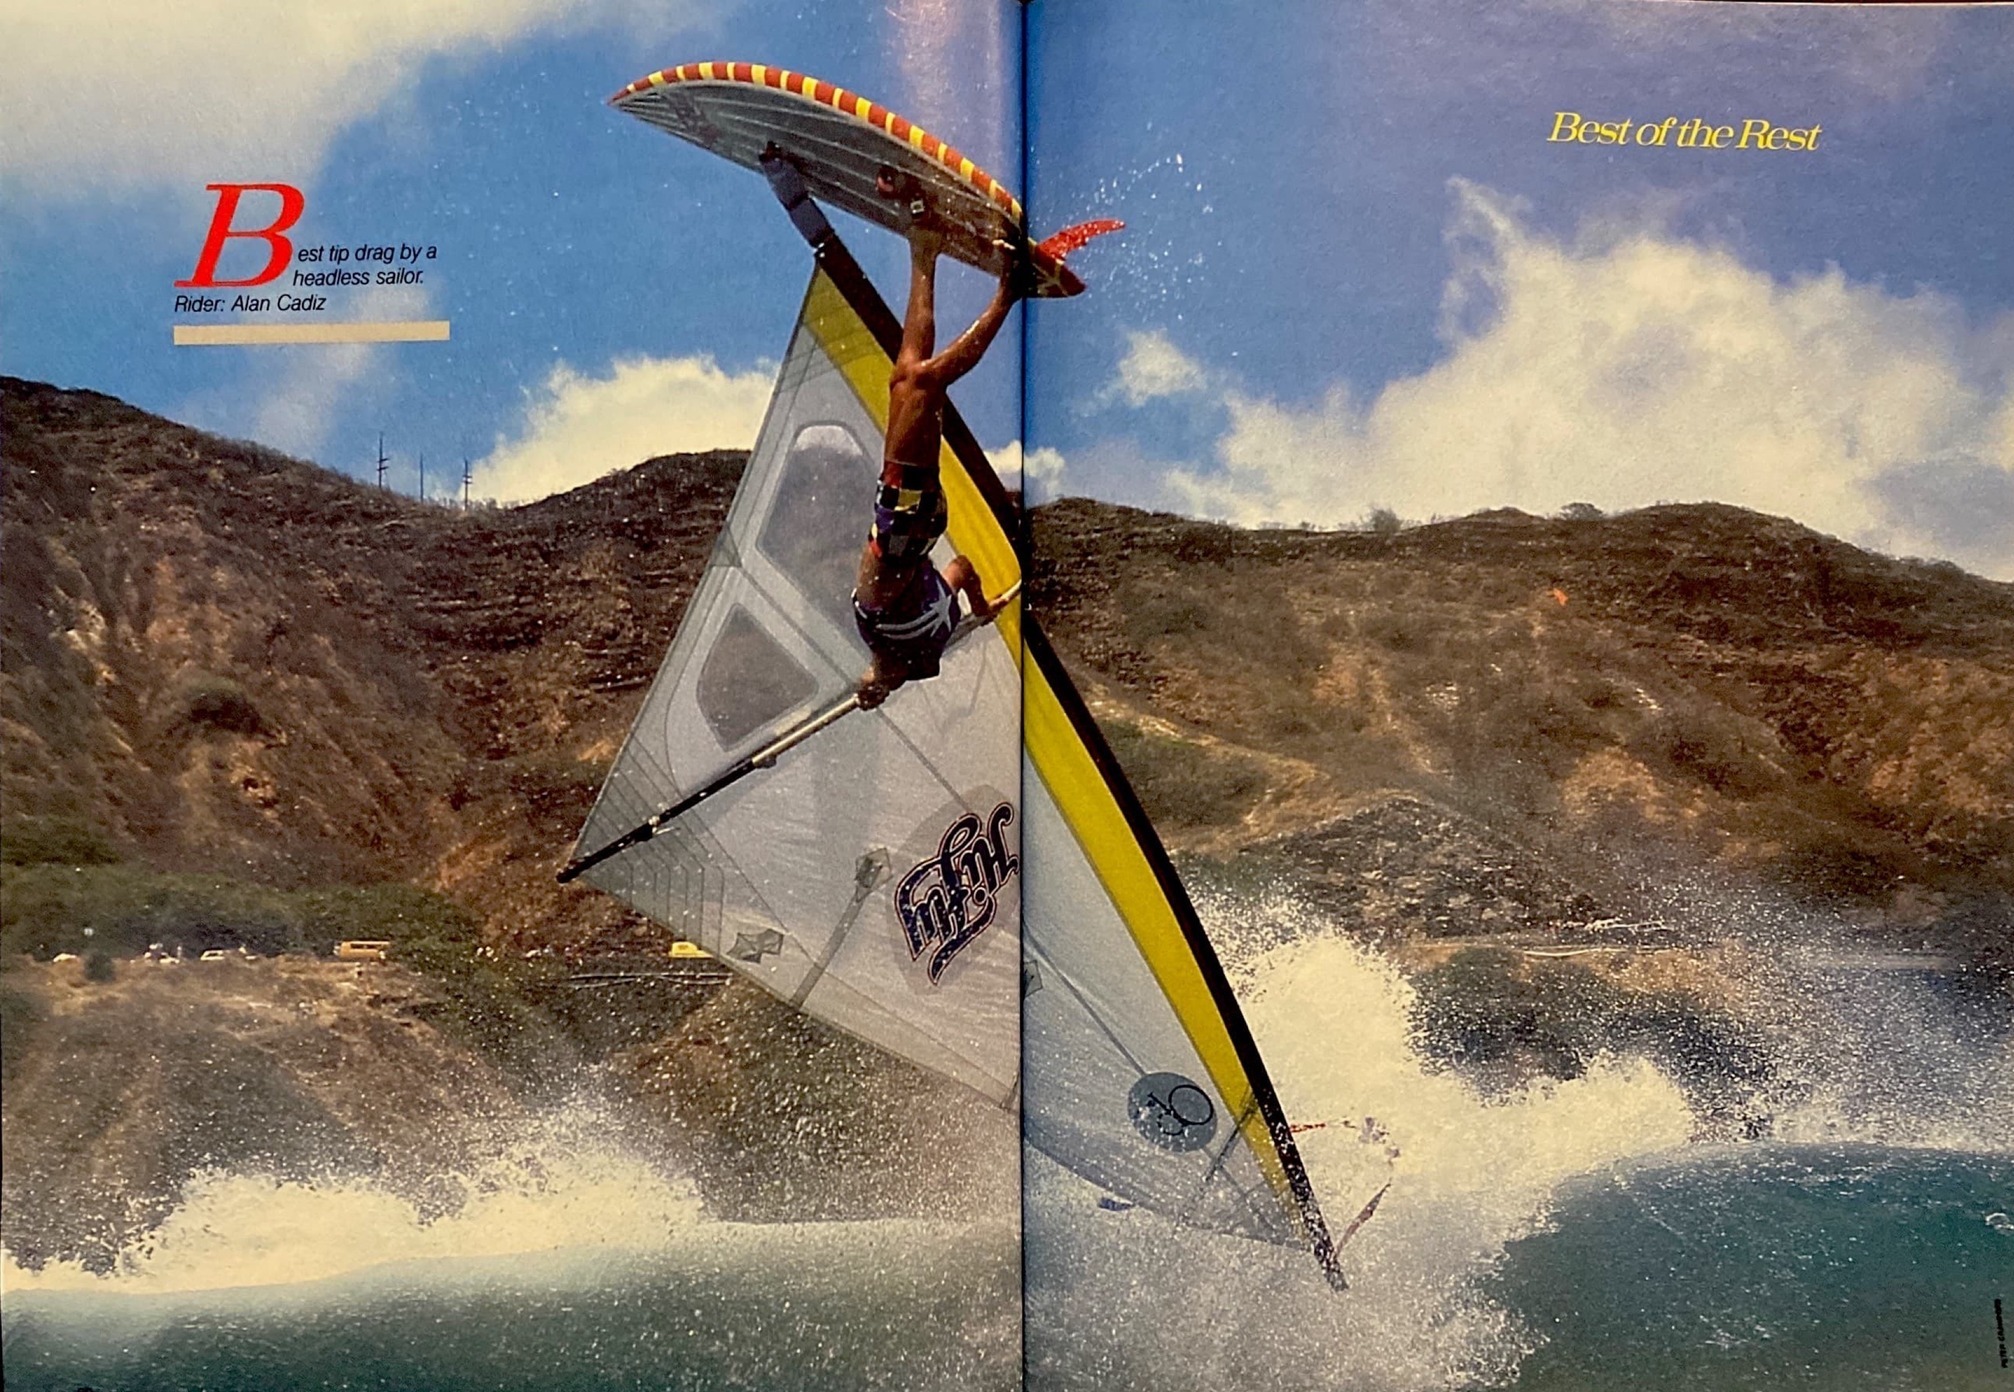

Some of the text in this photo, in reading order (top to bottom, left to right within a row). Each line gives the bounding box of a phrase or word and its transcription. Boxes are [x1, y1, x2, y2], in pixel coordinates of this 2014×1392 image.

[1546, 111, 1823, 151] Best of the Rest
[329, 245, 350, 264] tip
[355, 244, 395, 264] drag
[400, 243, 422, 264] by
[425, 245, 438, 260] a
[293, 267, 425, 286] headless sailor.
[174, 294, 327, 313] Rider: Alan Cadiz
